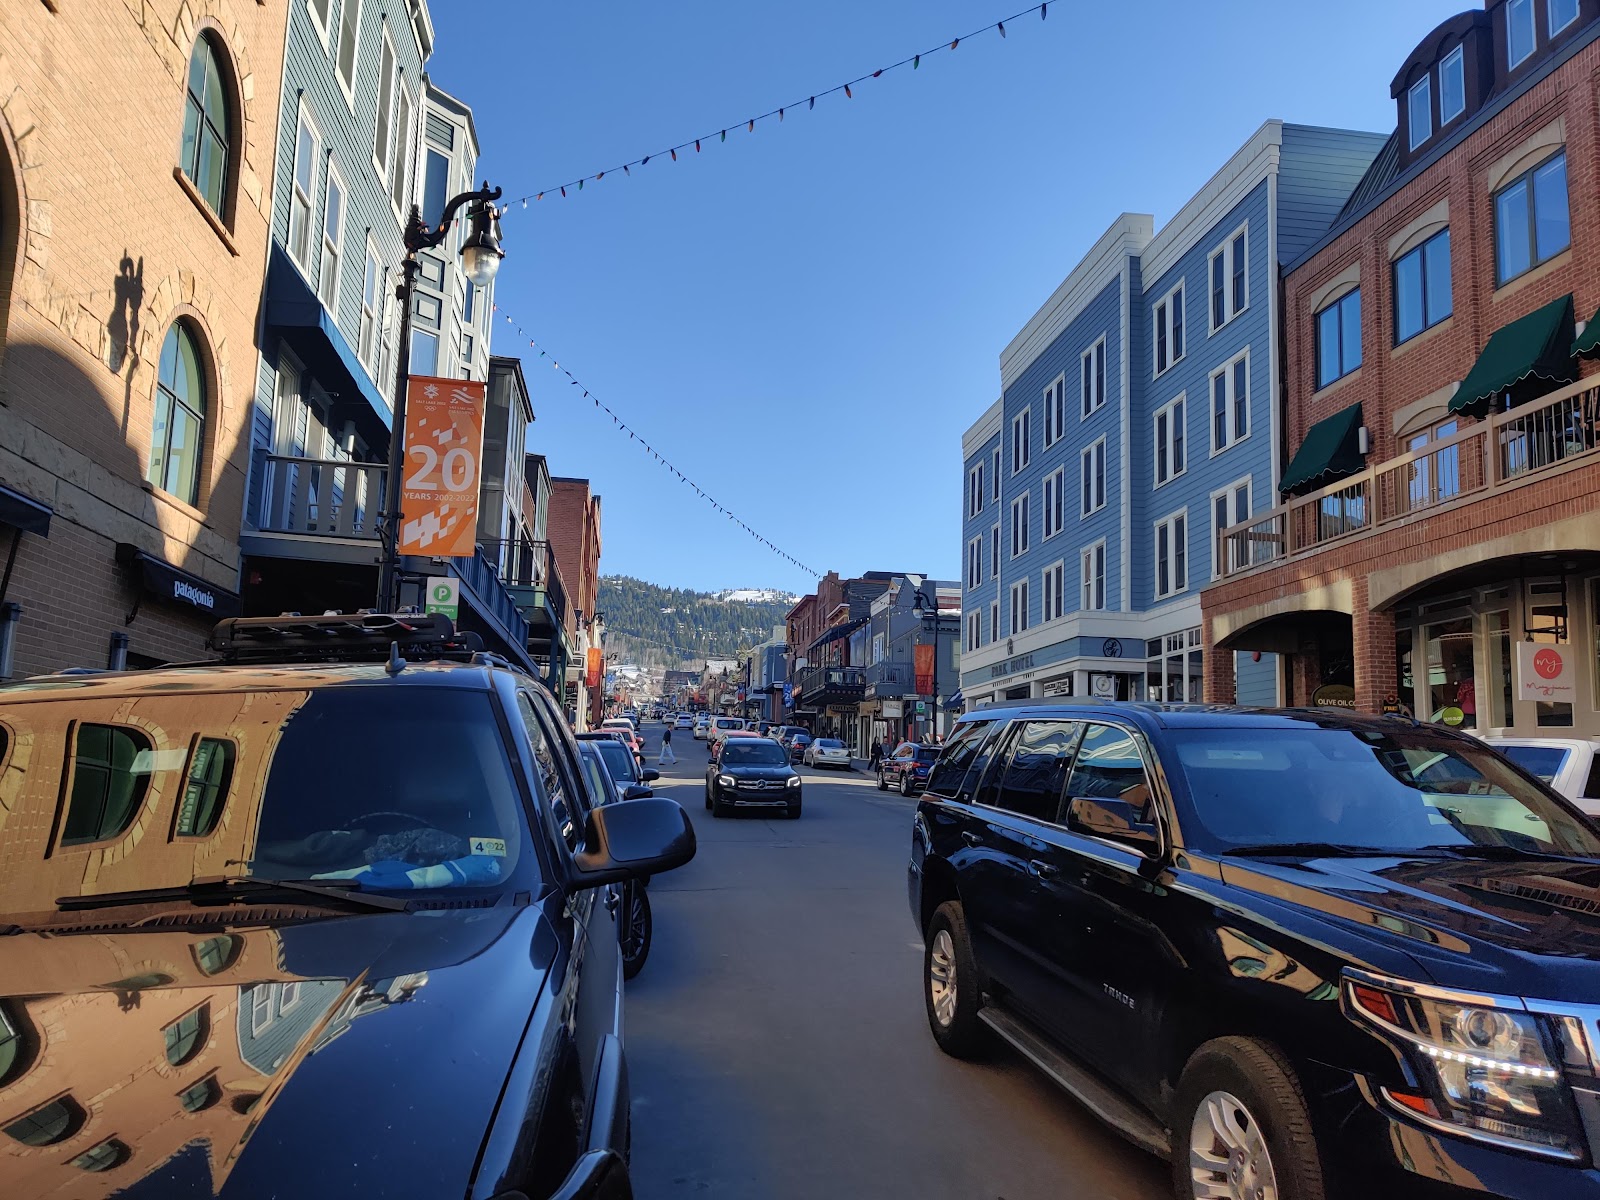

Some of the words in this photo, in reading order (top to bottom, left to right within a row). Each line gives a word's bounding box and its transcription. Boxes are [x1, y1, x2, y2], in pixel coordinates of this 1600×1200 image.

[405, 444, 475, 492] 20
[403, 492, 431, 500] YEARS
[434, 493, 475, 502] 2002-2022
[174, 580, 214, 609] patagonia
[991, 662, 1008, 678] PARK
[1010, 655, 1035, 672] HOTEL
[1317, 698, 1337, 706] OLIVE
[475, 841, 484, 852] 4
[494, 842, 504, 851] 22
[1103, 983, 1135, 1009] TAHOE
